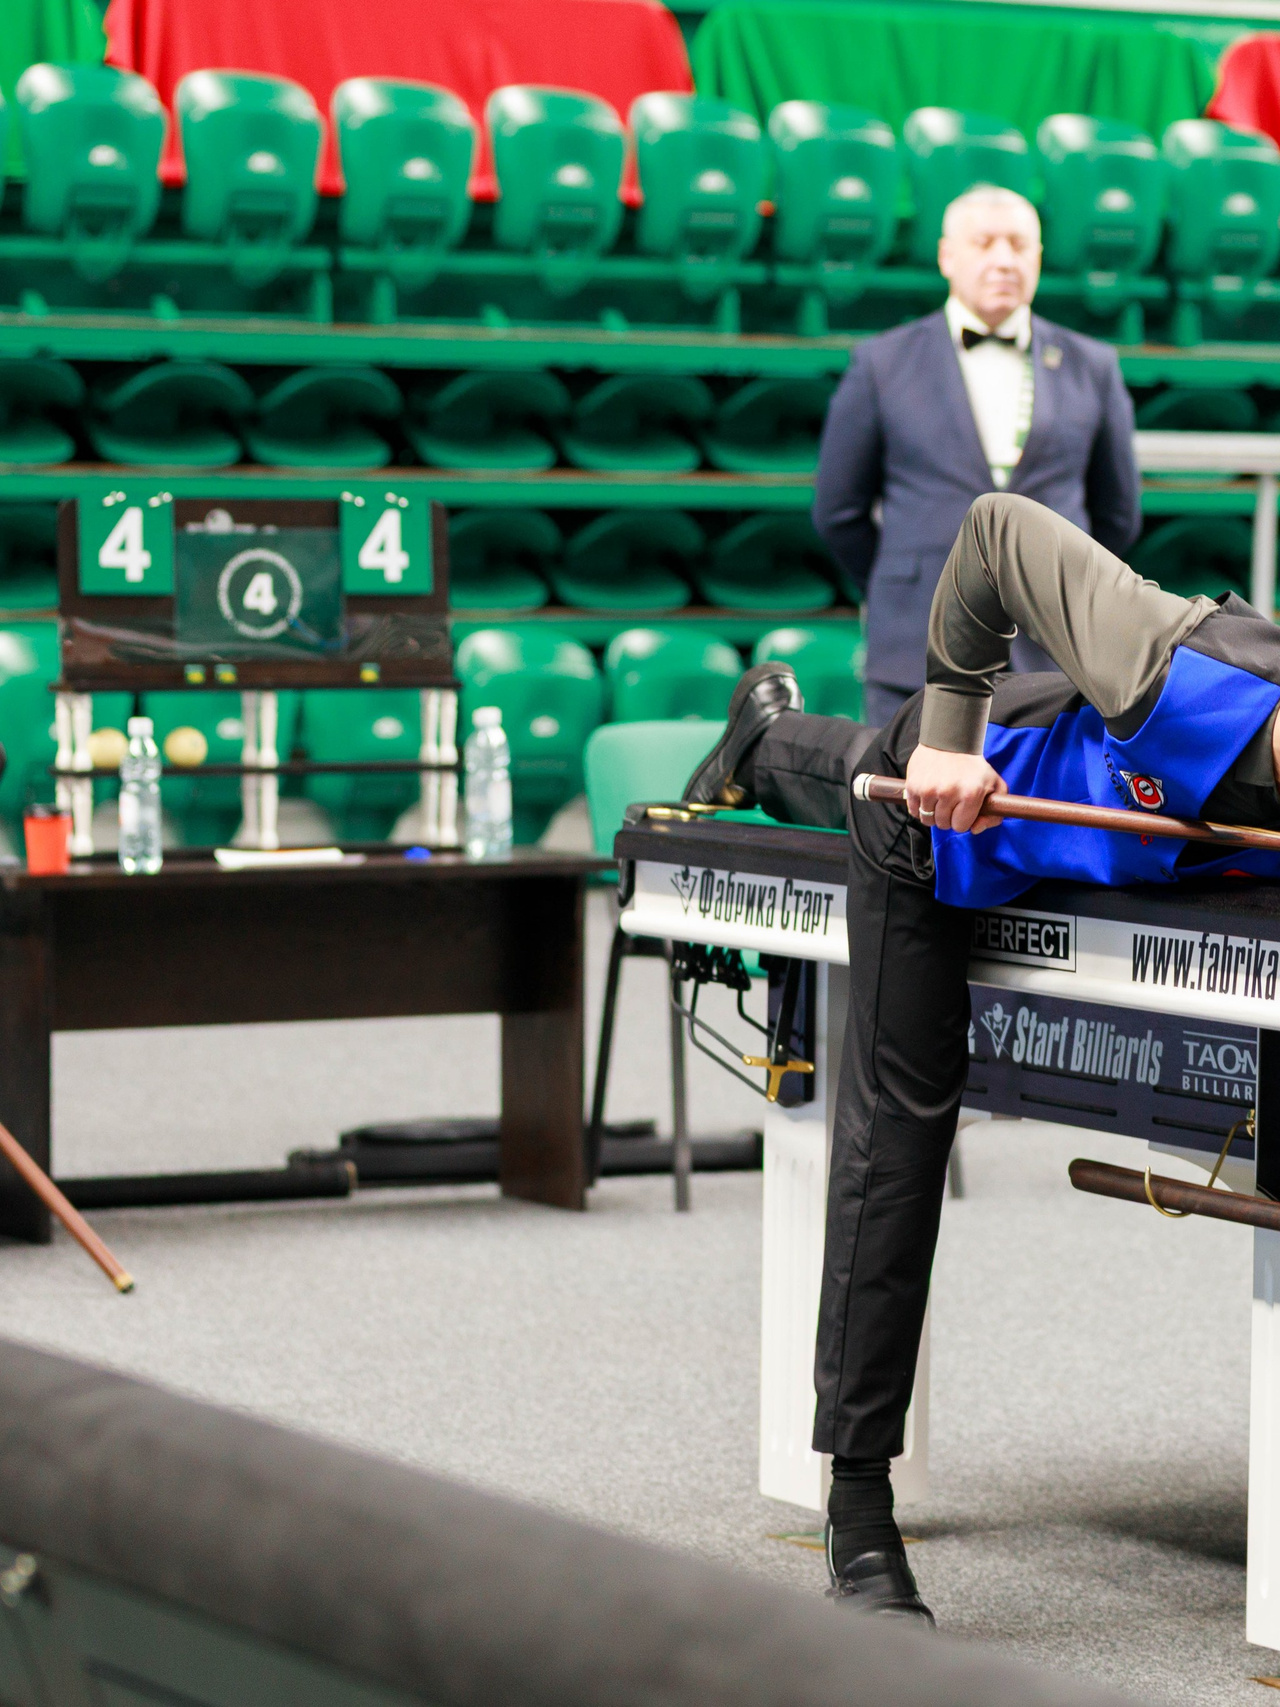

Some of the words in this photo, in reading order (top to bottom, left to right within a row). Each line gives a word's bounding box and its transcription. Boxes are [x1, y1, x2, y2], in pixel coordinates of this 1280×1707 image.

[98, 507, 151, 583] 4
[358, 508, 409, 584] 4
[242, 572, 278, 616] 4
[699, 868, 777, 929] Фабрика
[780, 878, 834, 936] Старт
[975, 915, 1068, 958] PERFECT
[1012, 1006, 1069, 1070] Start
[1070, 1018, 1164, 1086] Billiards
